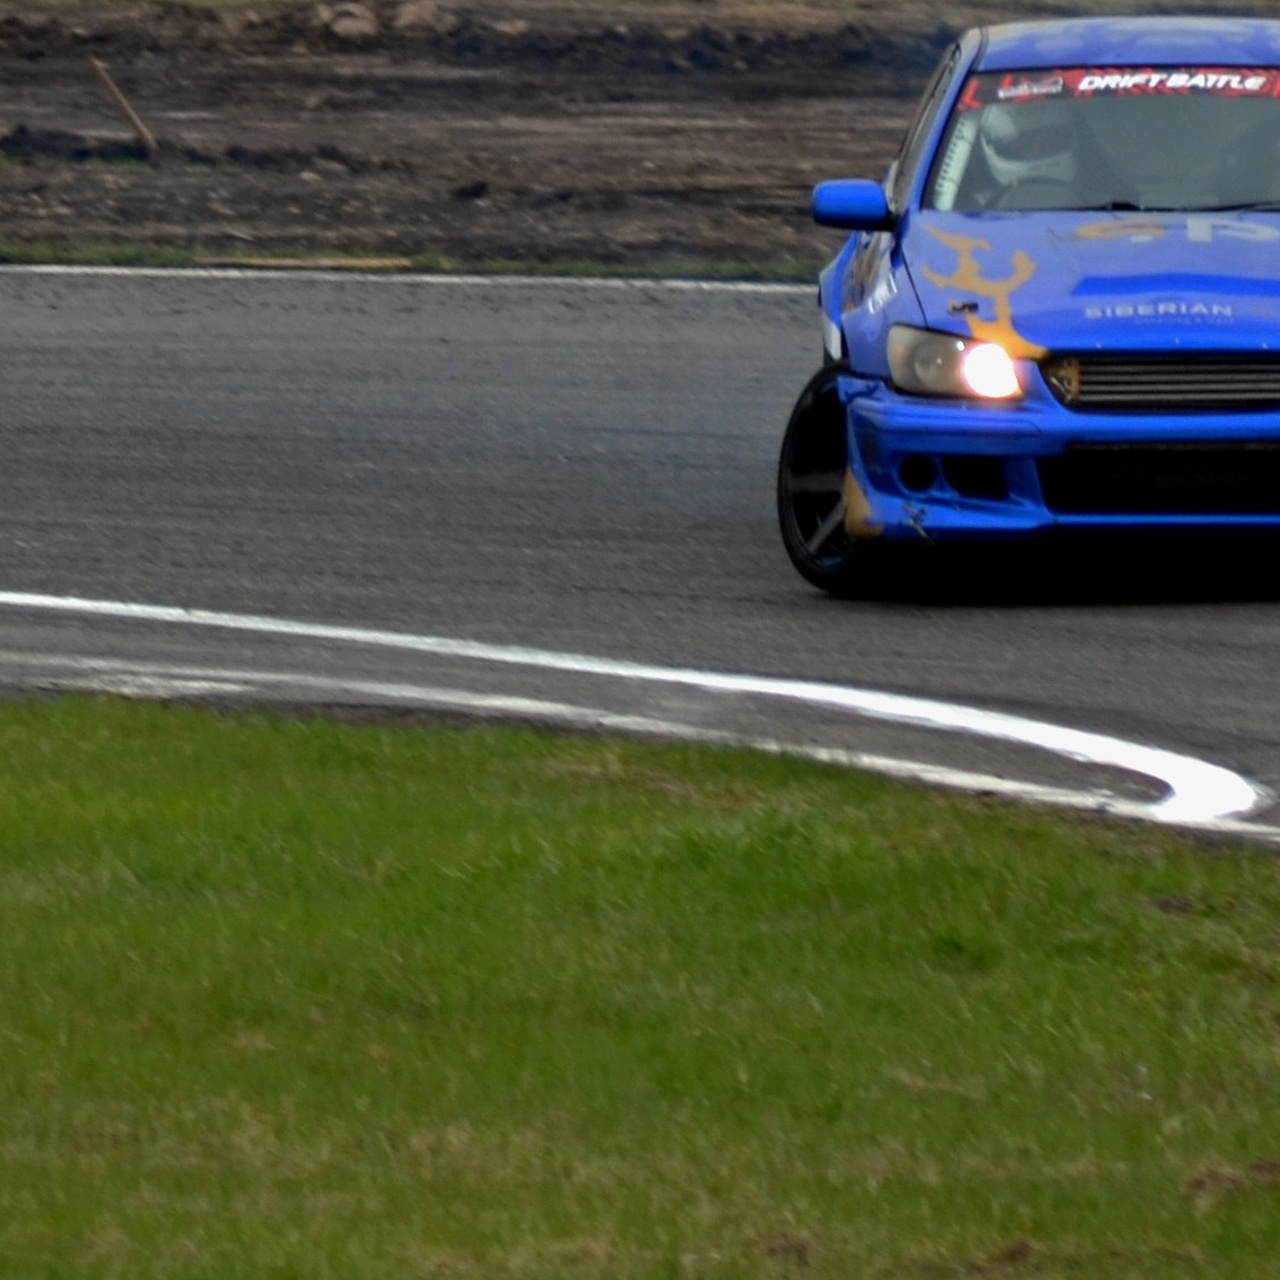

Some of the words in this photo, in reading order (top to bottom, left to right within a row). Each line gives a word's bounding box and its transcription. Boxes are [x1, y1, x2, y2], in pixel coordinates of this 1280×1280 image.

[1078, 73, 1167, 90] DRIFT
[1166, 73, 1266, 90] BATTLE
[1084, 302, 1233, 320] SIBERIAN
